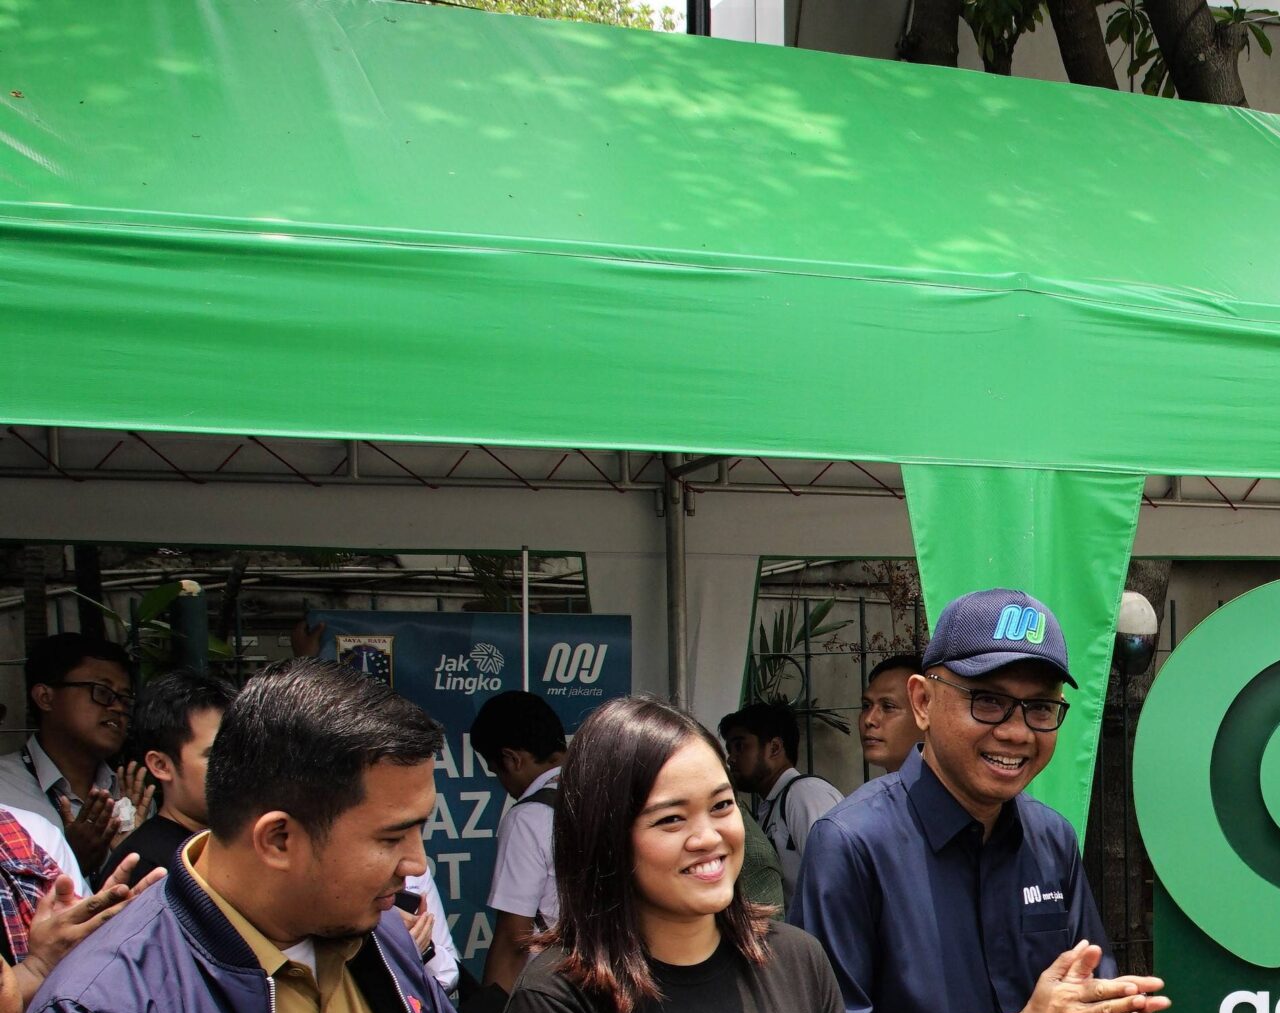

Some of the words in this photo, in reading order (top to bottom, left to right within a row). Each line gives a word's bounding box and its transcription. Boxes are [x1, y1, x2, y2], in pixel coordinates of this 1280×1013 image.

[435, 654, 470, 672] Jak
[434, 673, 502, 695] Lingko
[547, 687, 568, 696] mrt
[568, 686, 603, 697] jakarta
